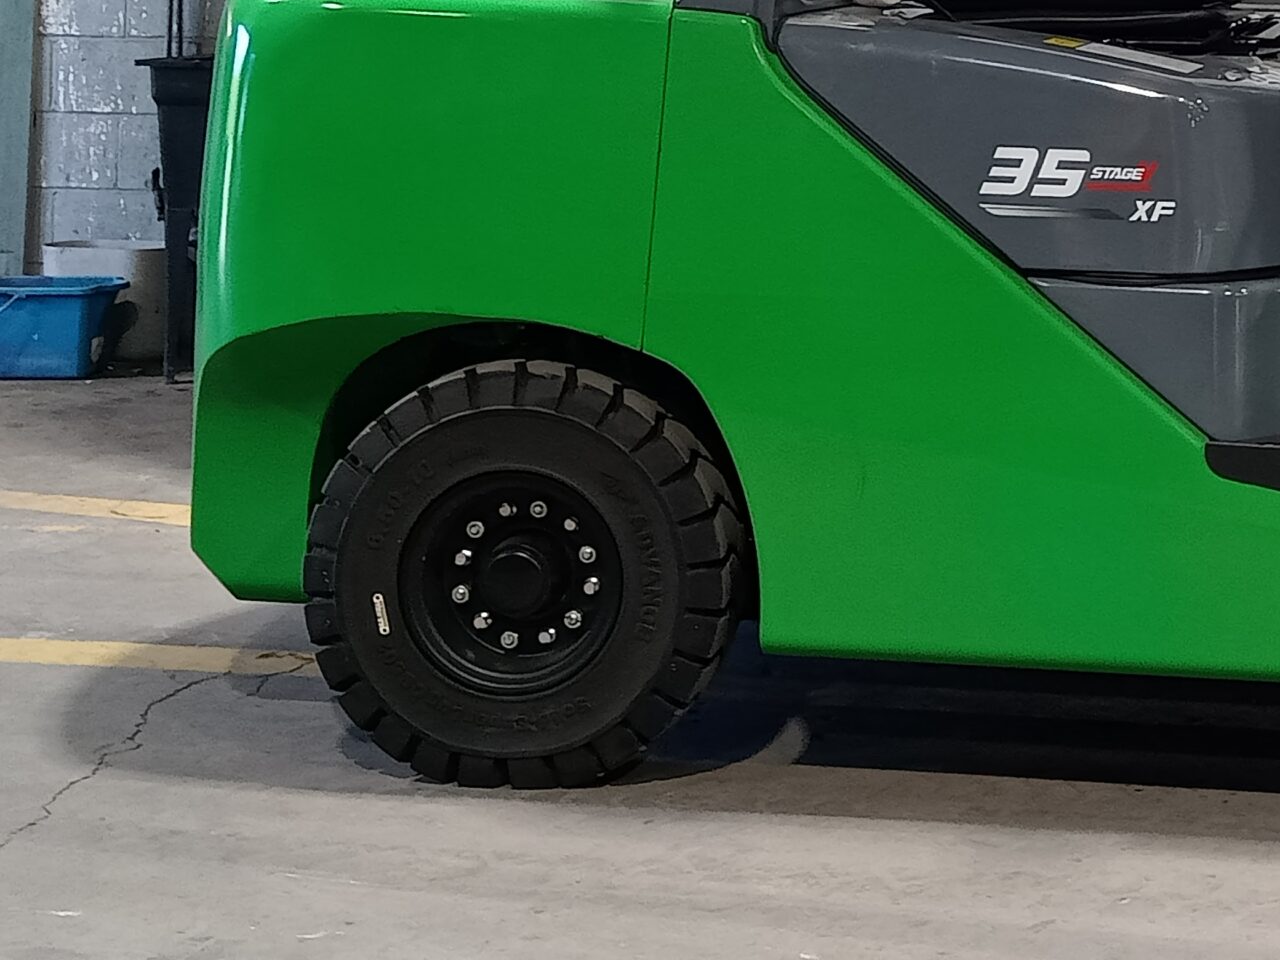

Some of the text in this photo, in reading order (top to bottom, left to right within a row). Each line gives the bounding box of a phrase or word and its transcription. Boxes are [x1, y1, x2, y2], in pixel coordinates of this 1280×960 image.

[979, 146, 1091, 197] 35
[1090, 166, 1146, 181] STAGE
[1128, 200, 1176, 222] XF
